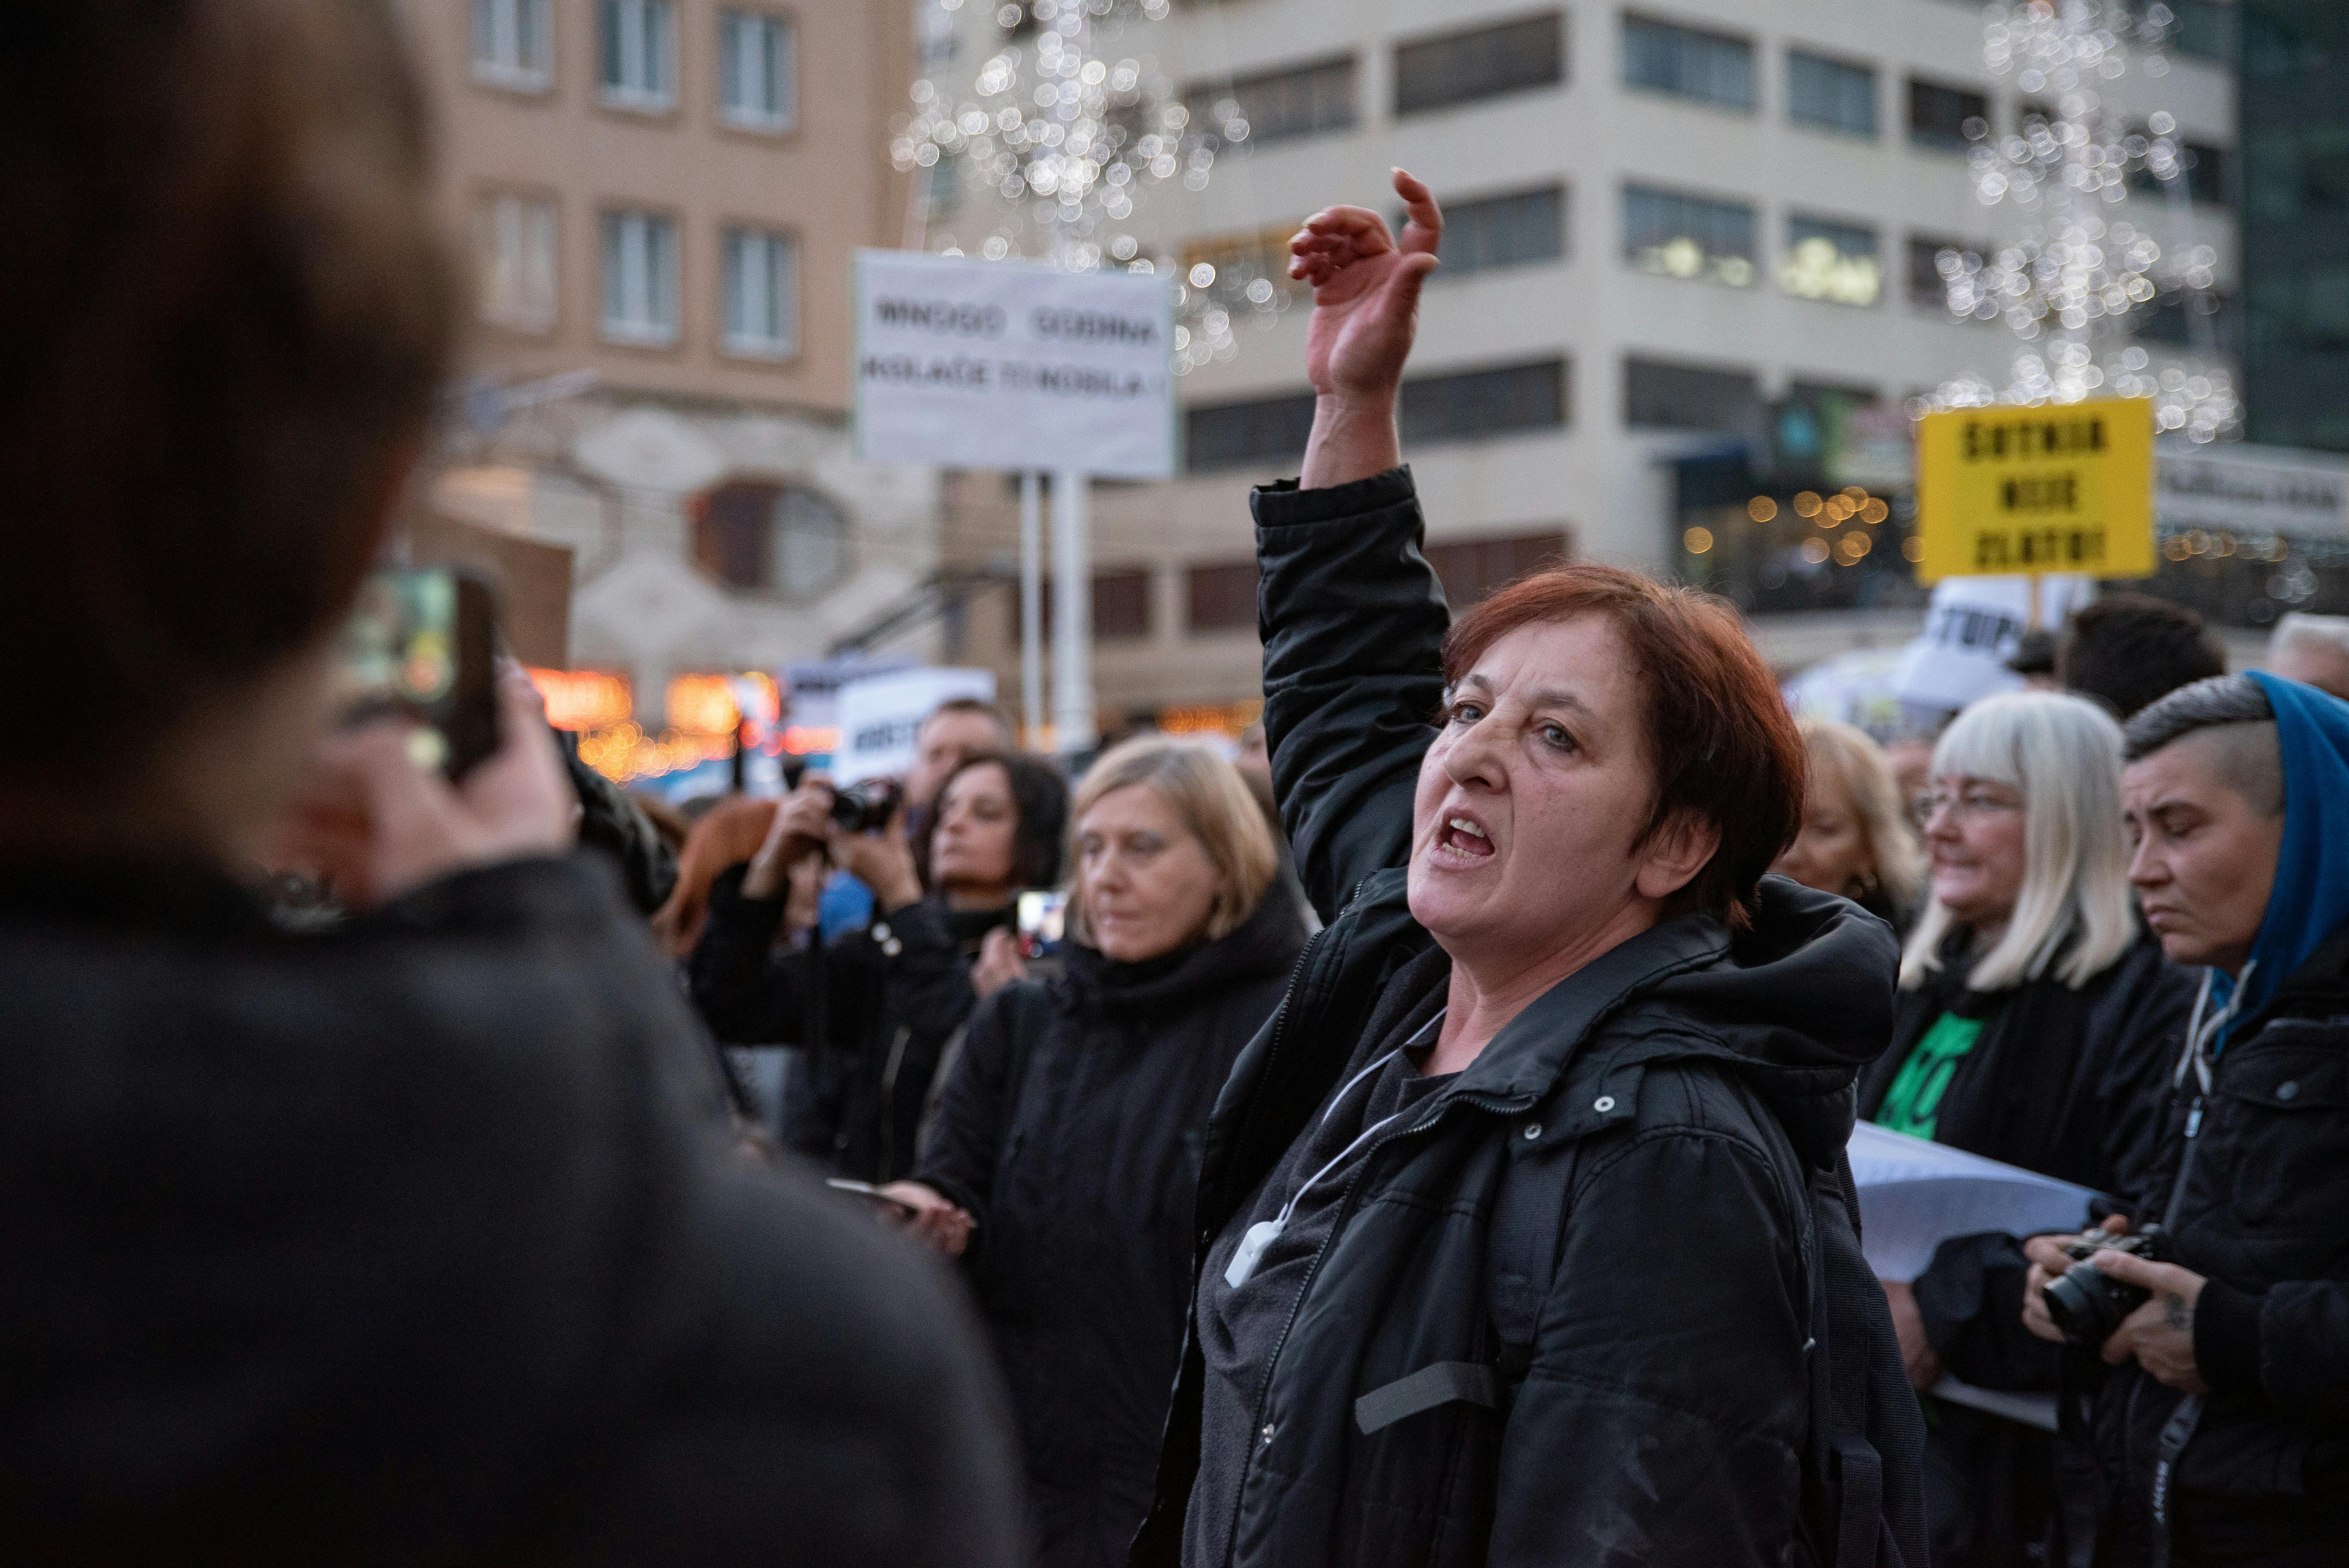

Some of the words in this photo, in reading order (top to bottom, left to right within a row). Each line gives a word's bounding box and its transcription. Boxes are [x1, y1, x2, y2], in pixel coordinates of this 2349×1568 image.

[874, 295, 1005, 339] MNOGO
[1028, 307, 1159, 349] GODINA
[1997, 471, 2082, 516] NIJE
